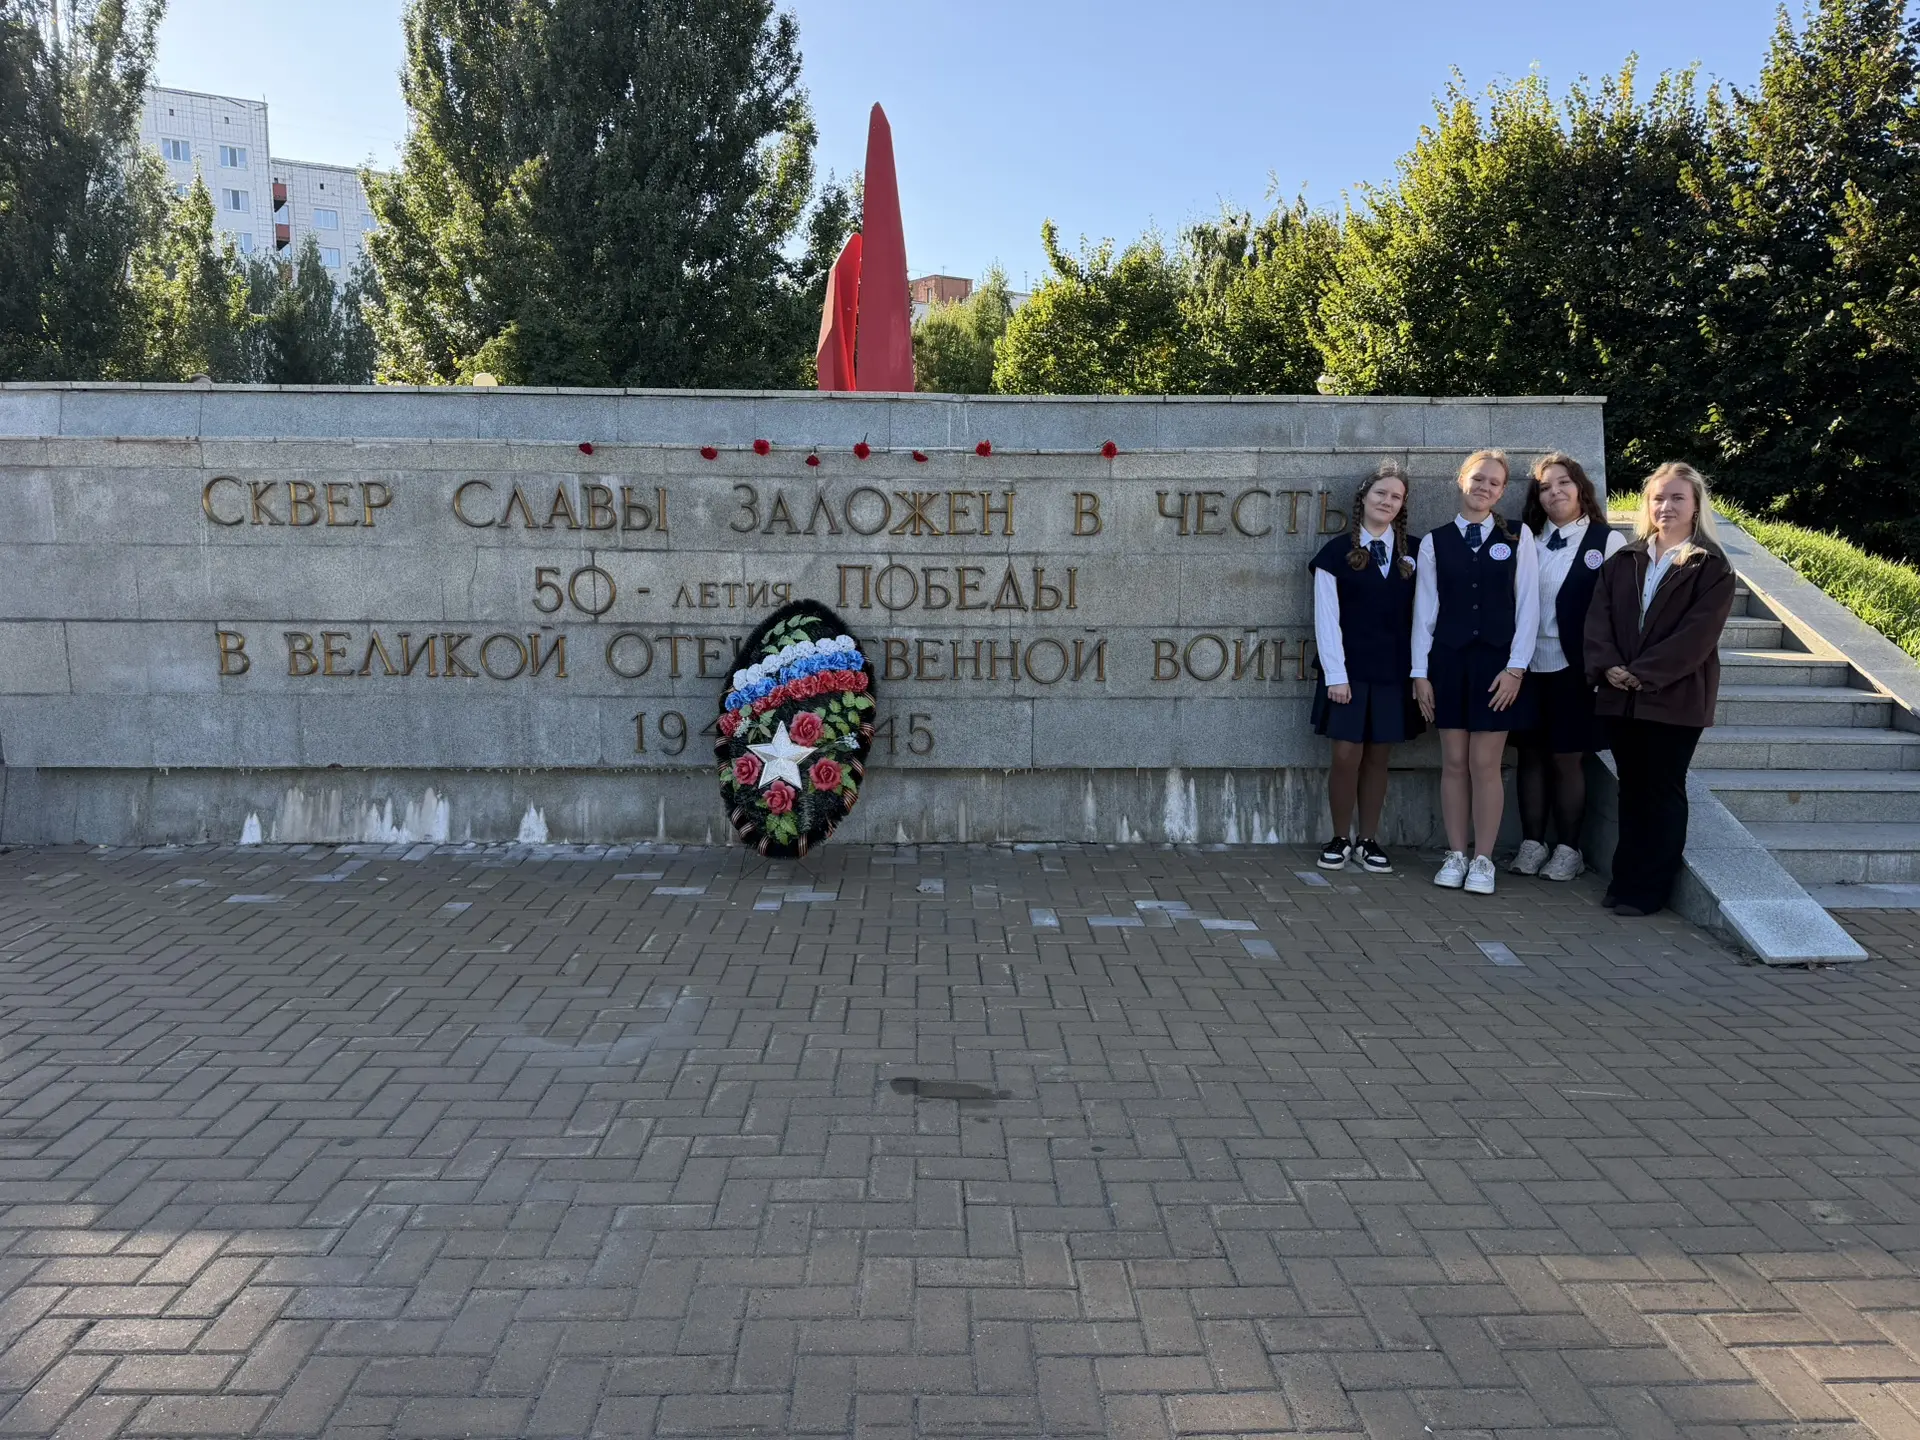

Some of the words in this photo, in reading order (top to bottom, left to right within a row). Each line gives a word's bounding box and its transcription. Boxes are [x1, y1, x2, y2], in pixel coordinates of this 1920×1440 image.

[202, 475, 394, 527] СКВЕР
[453, 480, 668, 531] СЛАВЫ
[730, 483, 1015, 537] ЗАЛОЖЕН
[1072, 491, 1102, 536] В
[1155, 487, 1349, 537] ЧЕСТЬ
[836, 562, 1078, 612] ПОБЕДЫ
[215, 630, 252, 676] В
[284, 625, 569, 681] ВЕЛИКОЙ
[605, 627, 1106, 684] ОТЕВЕННОЙ
[1151, 628, 1319, 681] ВОЙН
[631, 710, 719, 756] 19
